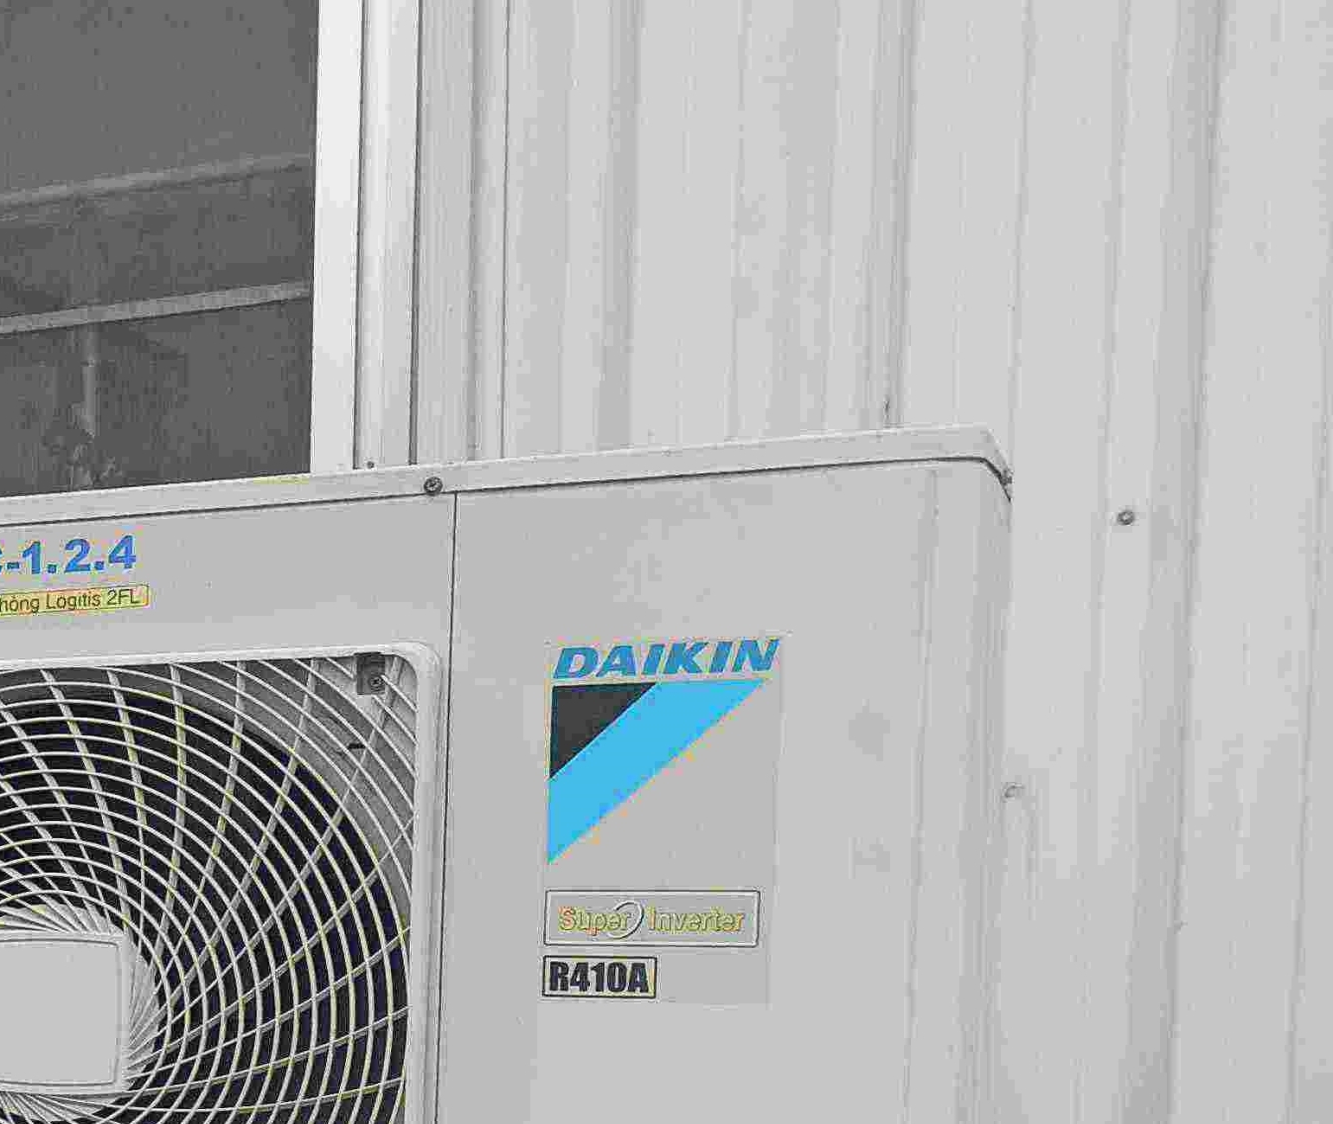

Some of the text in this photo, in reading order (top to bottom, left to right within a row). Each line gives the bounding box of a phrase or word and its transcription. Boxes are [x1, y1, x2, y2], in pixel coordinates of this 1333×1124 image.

[46, 590, 101, 611] Logitis
[107, 588, 141, 606] 2FL
[552, 639, 781, 680] DAIKIN
[558, 906, 745, 936] Super Inverter
[549, 961, 650, 993] R410A
